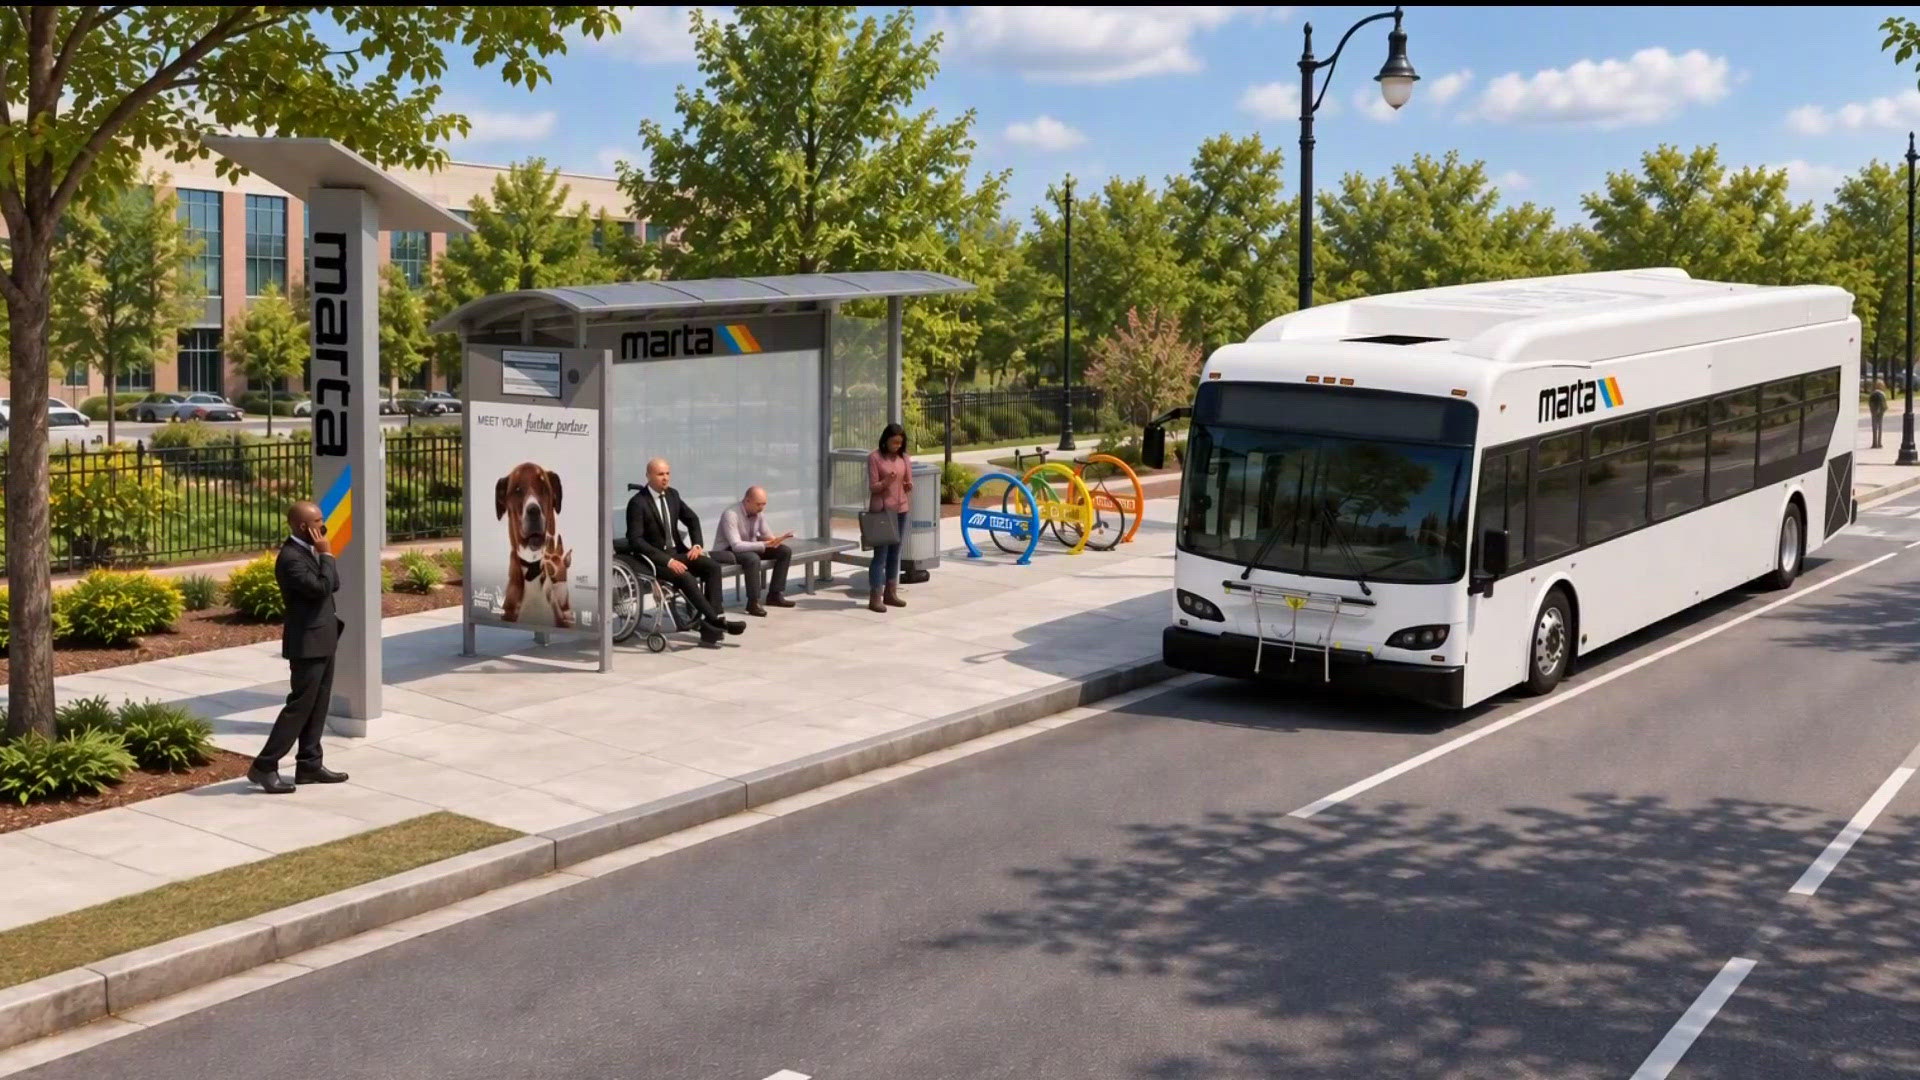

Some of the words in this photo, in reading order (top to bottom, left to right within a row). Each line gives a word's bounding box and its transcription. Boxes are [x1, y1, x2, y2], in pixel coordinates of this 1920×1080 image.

[313, 231, 350, 457] marta
[621, 324, 714, 360] marta
[1538, 379, 1597, 423] marta
[477, 415, 500, 427] MEET
[501, 416, 523, 429] YOUR
